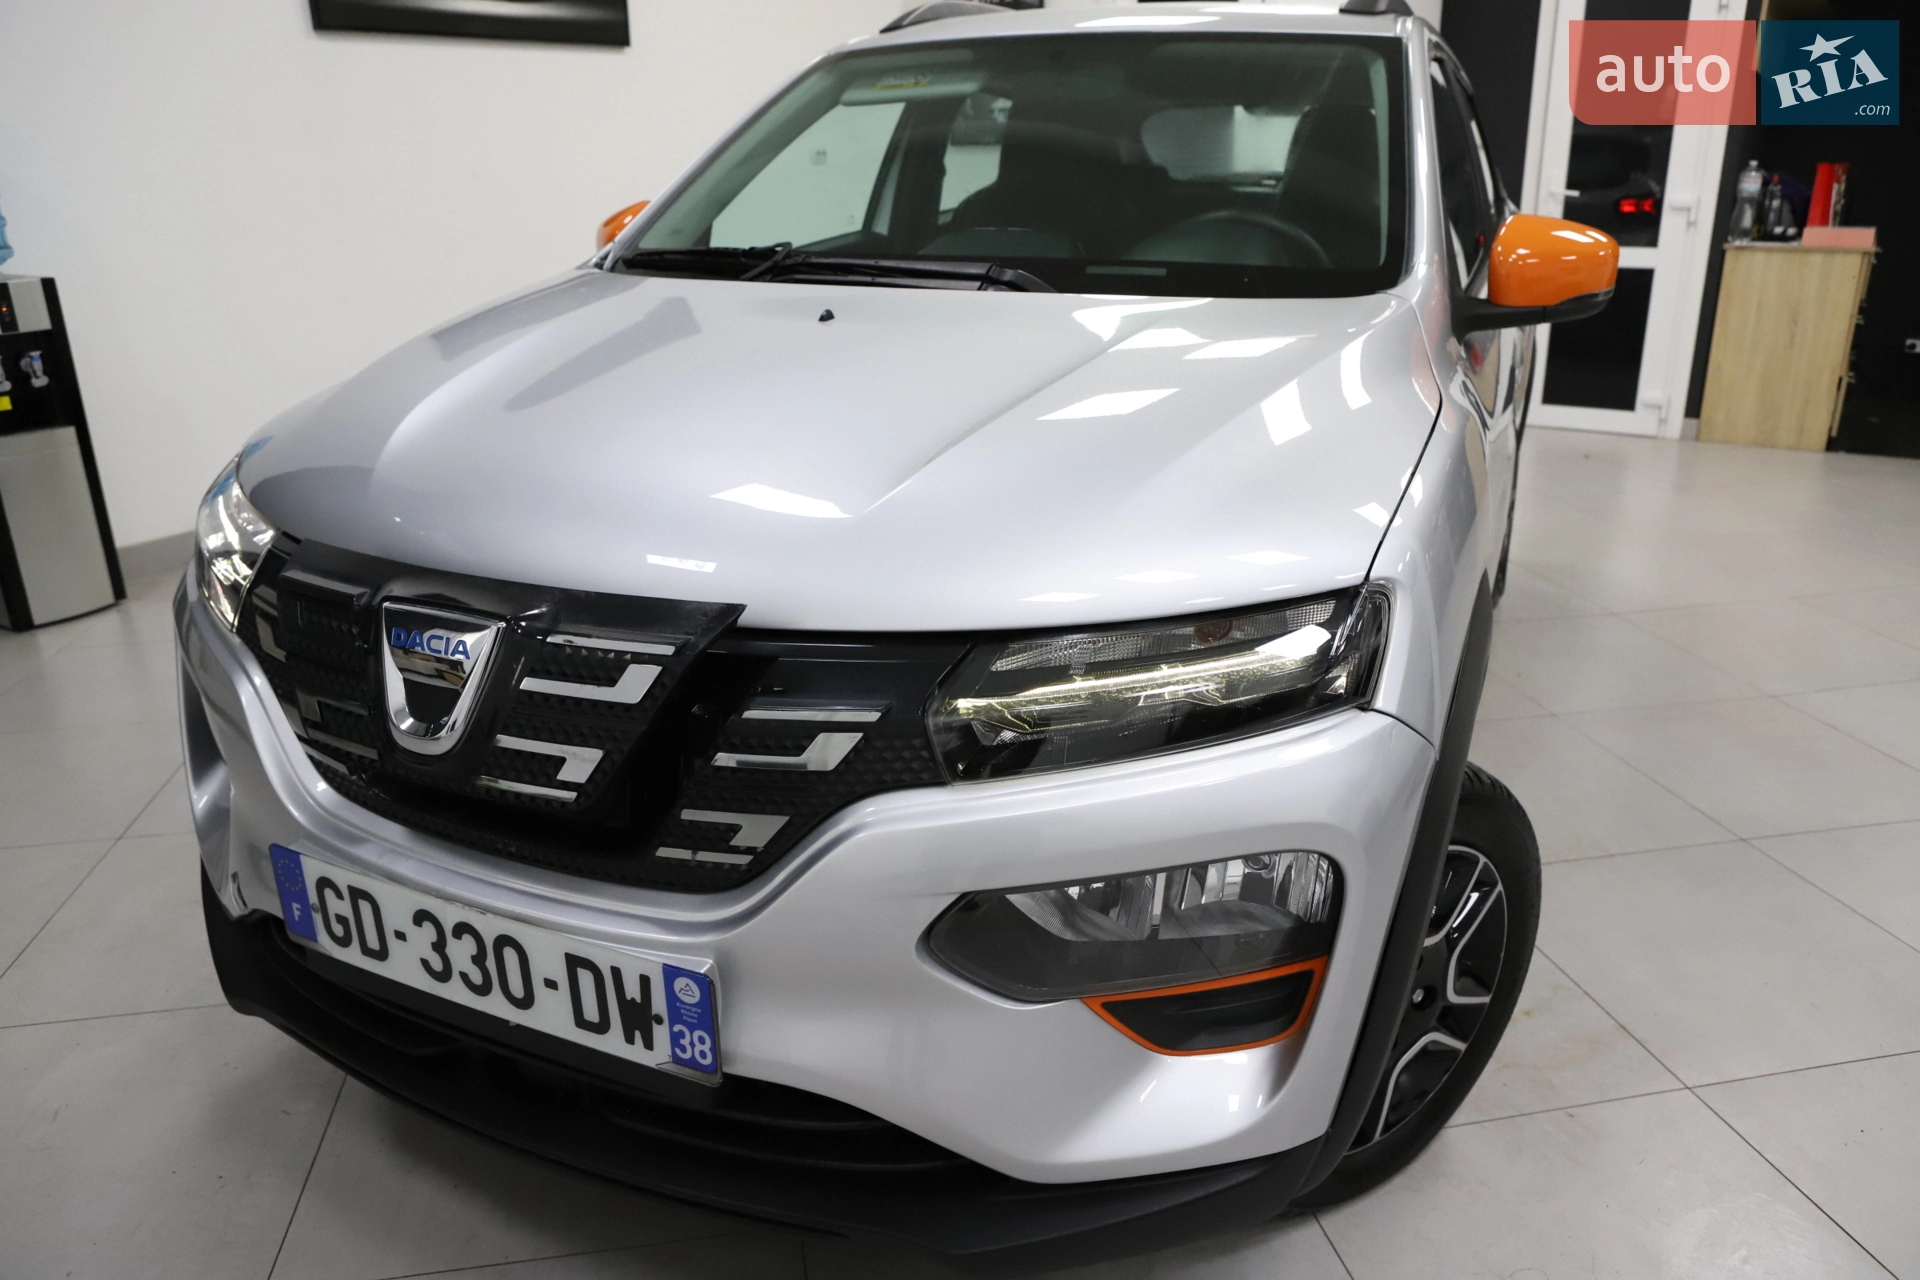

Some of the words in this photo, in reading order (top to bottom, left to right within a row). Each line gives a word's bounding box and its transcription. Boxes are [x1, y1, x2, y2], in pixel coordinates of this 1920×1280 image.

[390, 627, 471, 660] DACIA
[291, 902, 301, 922] F
[315, 875, 655, 1051] GD-330-DW
[672, 1024, 713, 1066] 38
